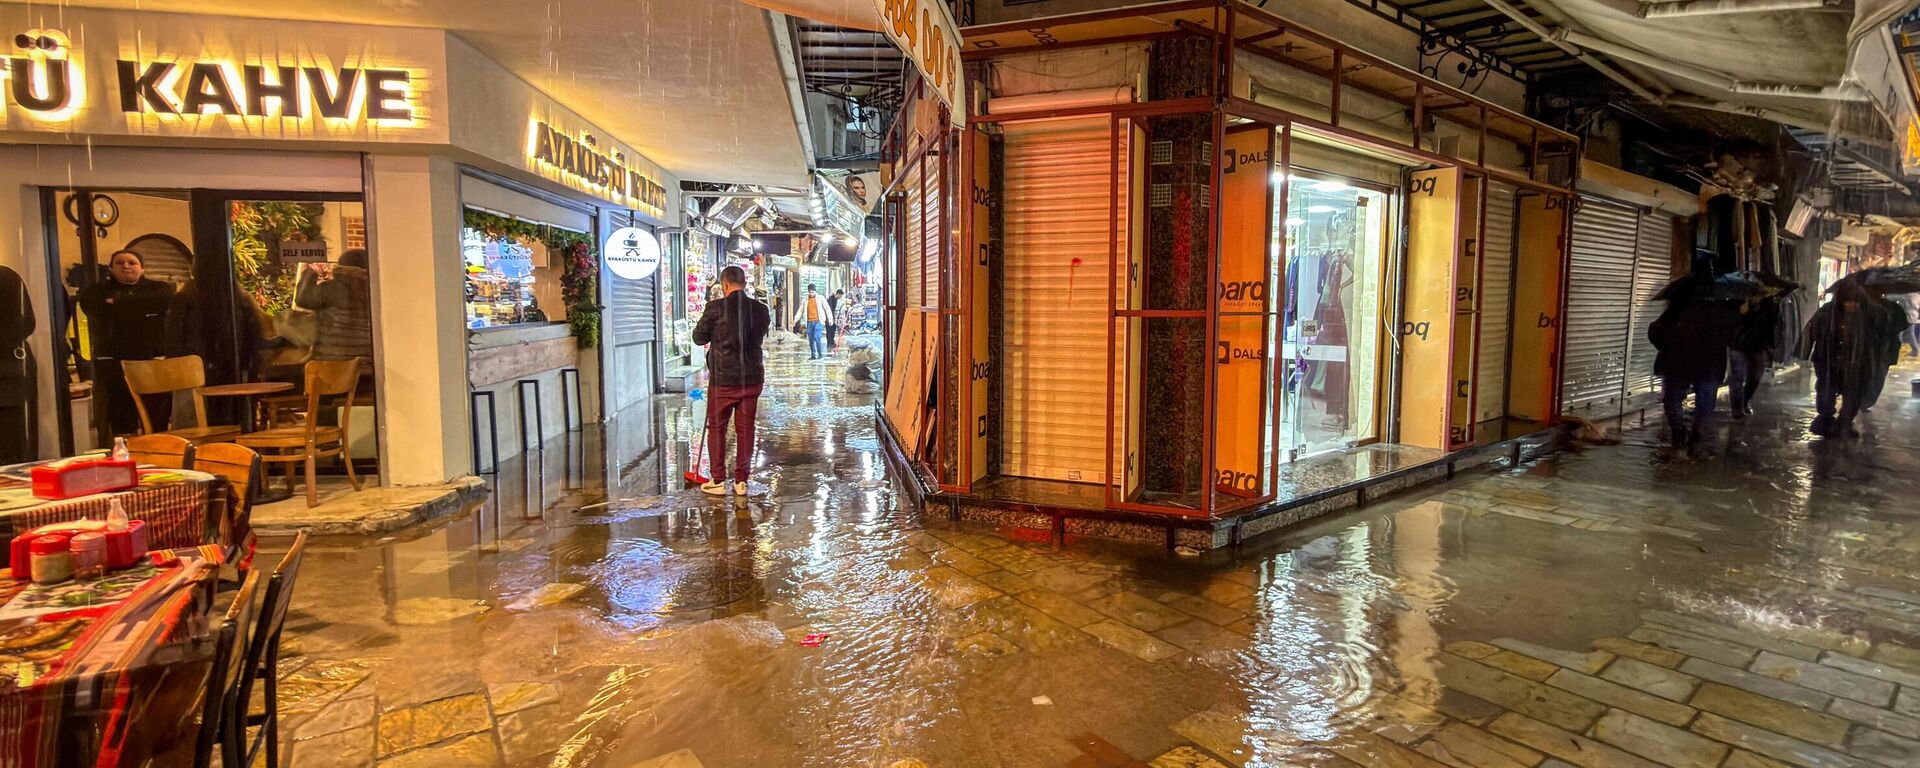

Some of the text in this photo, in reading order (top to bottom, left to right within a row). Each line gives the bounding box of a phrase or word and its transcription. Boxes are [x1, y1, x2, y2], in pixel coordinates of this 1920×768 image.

[117, 59, 411, 121] KAHVE
[537, 121, 626, 197] AYAKÜSTÜ
[282, 248, 298, 257] SELF
